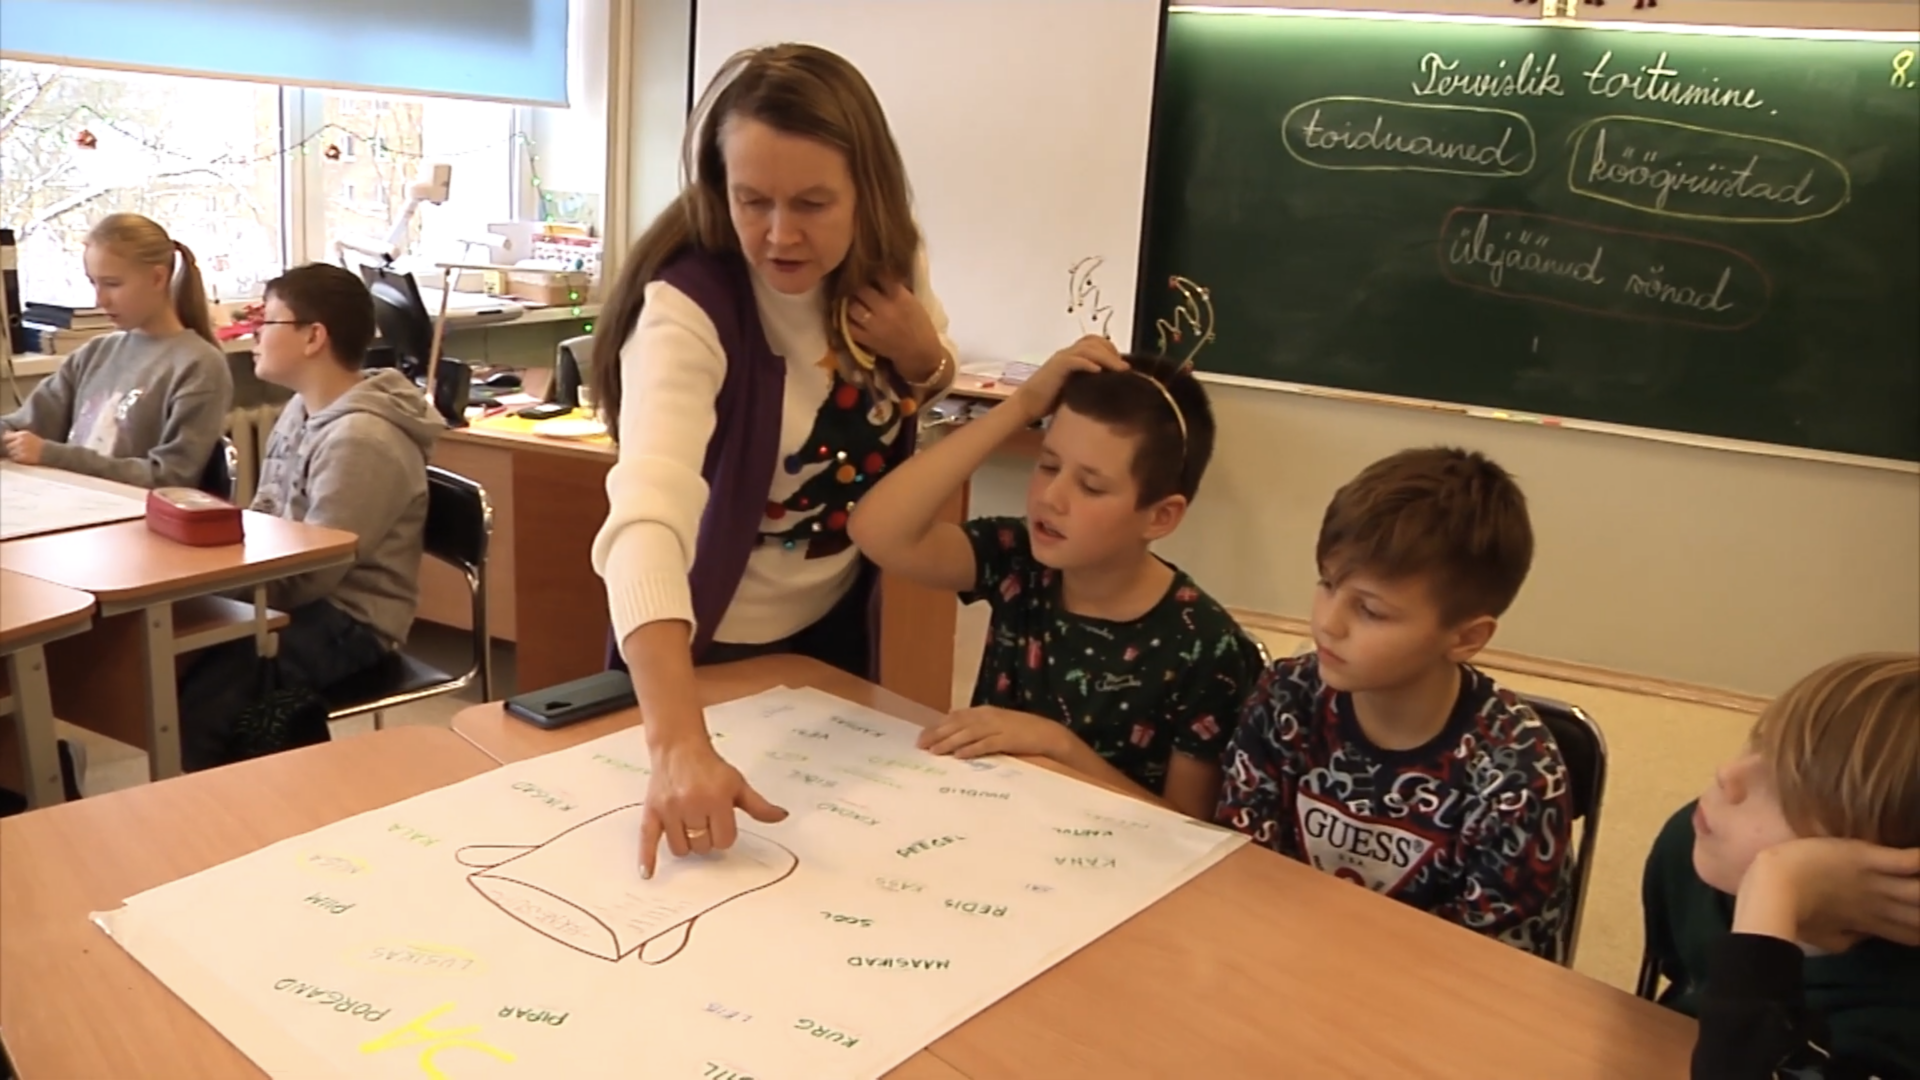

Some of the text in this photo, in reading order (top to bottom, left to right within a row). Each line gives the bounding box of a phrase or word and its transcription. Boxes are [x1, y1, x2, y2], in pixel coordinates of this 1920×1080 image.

[1412, 50, 1778, 116] Tervislik toitumine.
[1302, 108, 1522, 166] toiduained
[1451, 213, 1734, 311] ülejäänud sõnad
[1304, 807, 1412, 869] GUESS
[273, 977, 392, 1023] PORGAND
[498, 1005, 571, 1028] PIPAR
[793, 1017, 861, 1049] KURG
